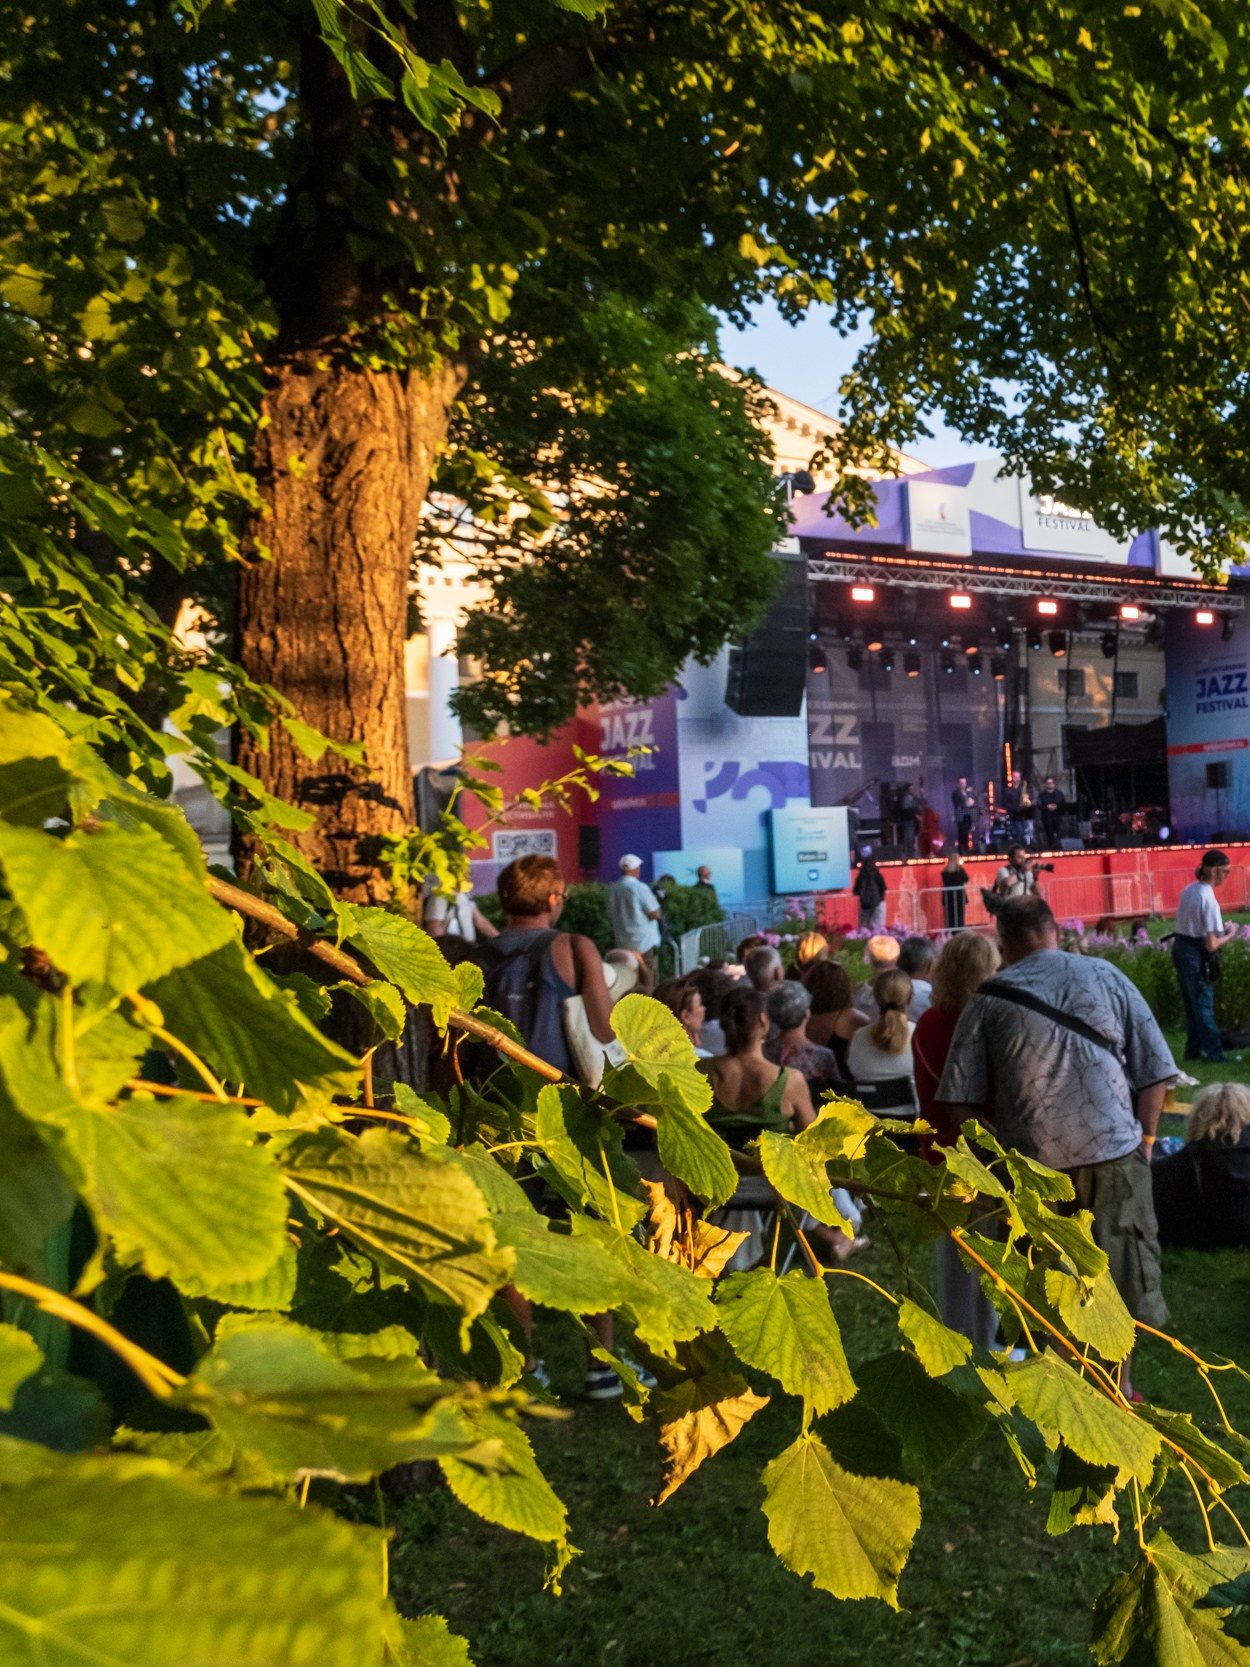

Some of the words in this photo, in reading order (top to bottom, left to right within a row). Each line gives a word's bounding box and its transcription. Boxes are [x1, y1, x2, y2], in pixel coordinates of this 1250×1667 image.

[1038, 517, 1091, 532] FESTIVAL
[1196, 672, 1249, 699] JAZZ
[1196, 697, 1249, 714] FESTIVAL
[600, 709, 655, 751] JAZZ
